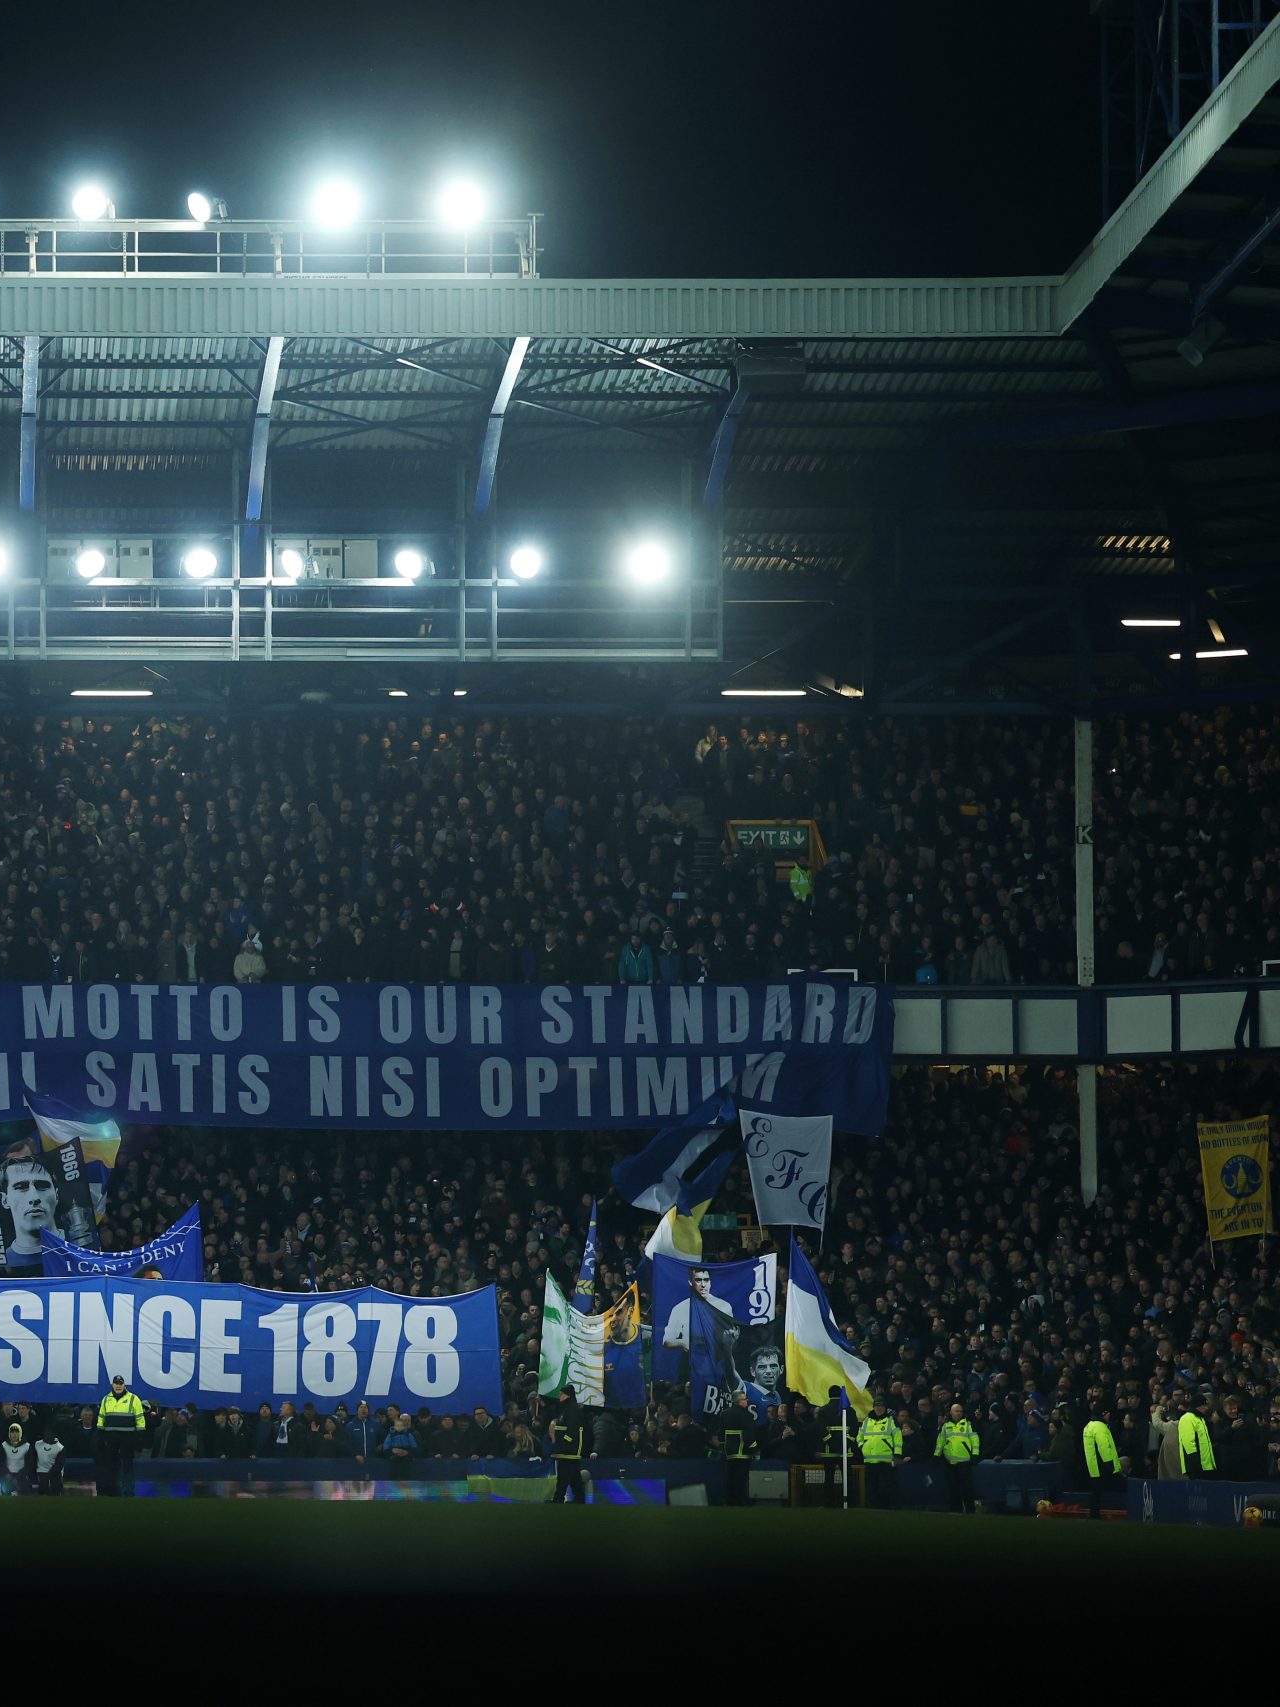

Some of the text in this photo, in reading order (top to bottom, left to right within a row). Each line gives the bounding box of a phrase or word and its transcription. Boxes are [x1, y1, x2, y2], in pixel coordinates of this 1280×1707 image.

[737, 830, 777, 846] EXIT
[1074, 825, 1094, 844] K
[23, 983, 243, 1042] MOTTO
[282, 985, 341, 1043] IS
[379, 985, 502, 1044] OUR
[541, 982, 877, 1044] STANDARD
[85, 1050, 270, 1114] SATIS
[310, 1056, 441, 1117] NISI
[60, 1144, 81, 1182] 1966
[77, 1260, 133, 1273] CAN'T
[141, 1240, 185, 1265] DENY
[258, 1302, 460, 1398] 1878
